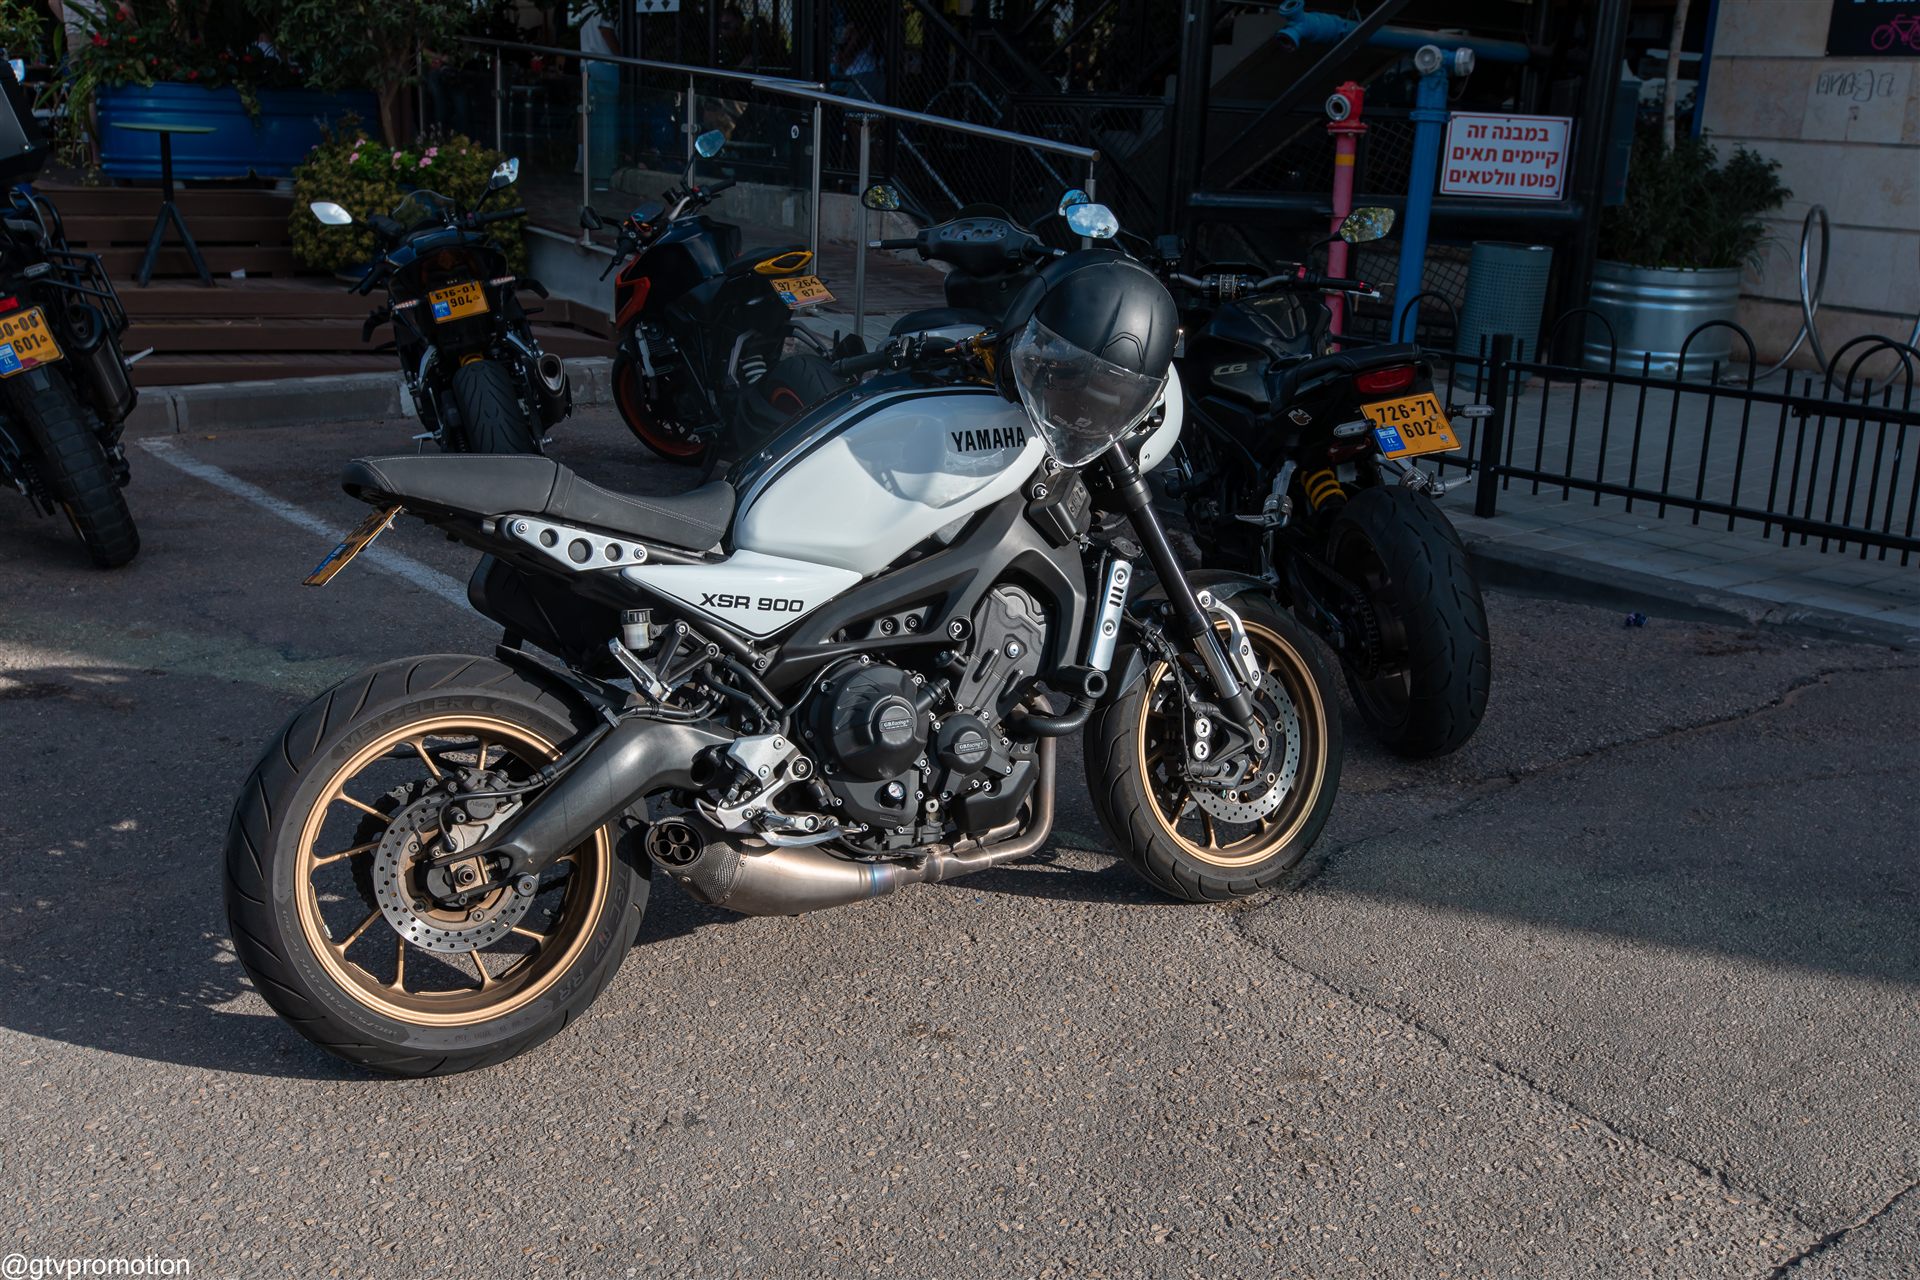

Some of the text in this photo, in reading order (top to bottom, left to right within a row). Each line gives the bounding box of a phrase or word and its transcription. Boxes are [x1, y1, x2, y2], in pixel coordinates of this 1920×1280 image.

[1467, 124, 1549, 142] במבנה זה
[1452, 146, 1559, 169] קיימים תאים
[1449, 168, 1556, 188] פוטו וולטאים
[450, 295, 473, 308] 904
[13, 333, 41, 354] 601
[1376, 399, 1438, 423] 726-71
[951, 426, 1027, 453] YAMAHA
[1403, 420, 1436, 439] 602
[699, 592, 804, 612] XSR 900
